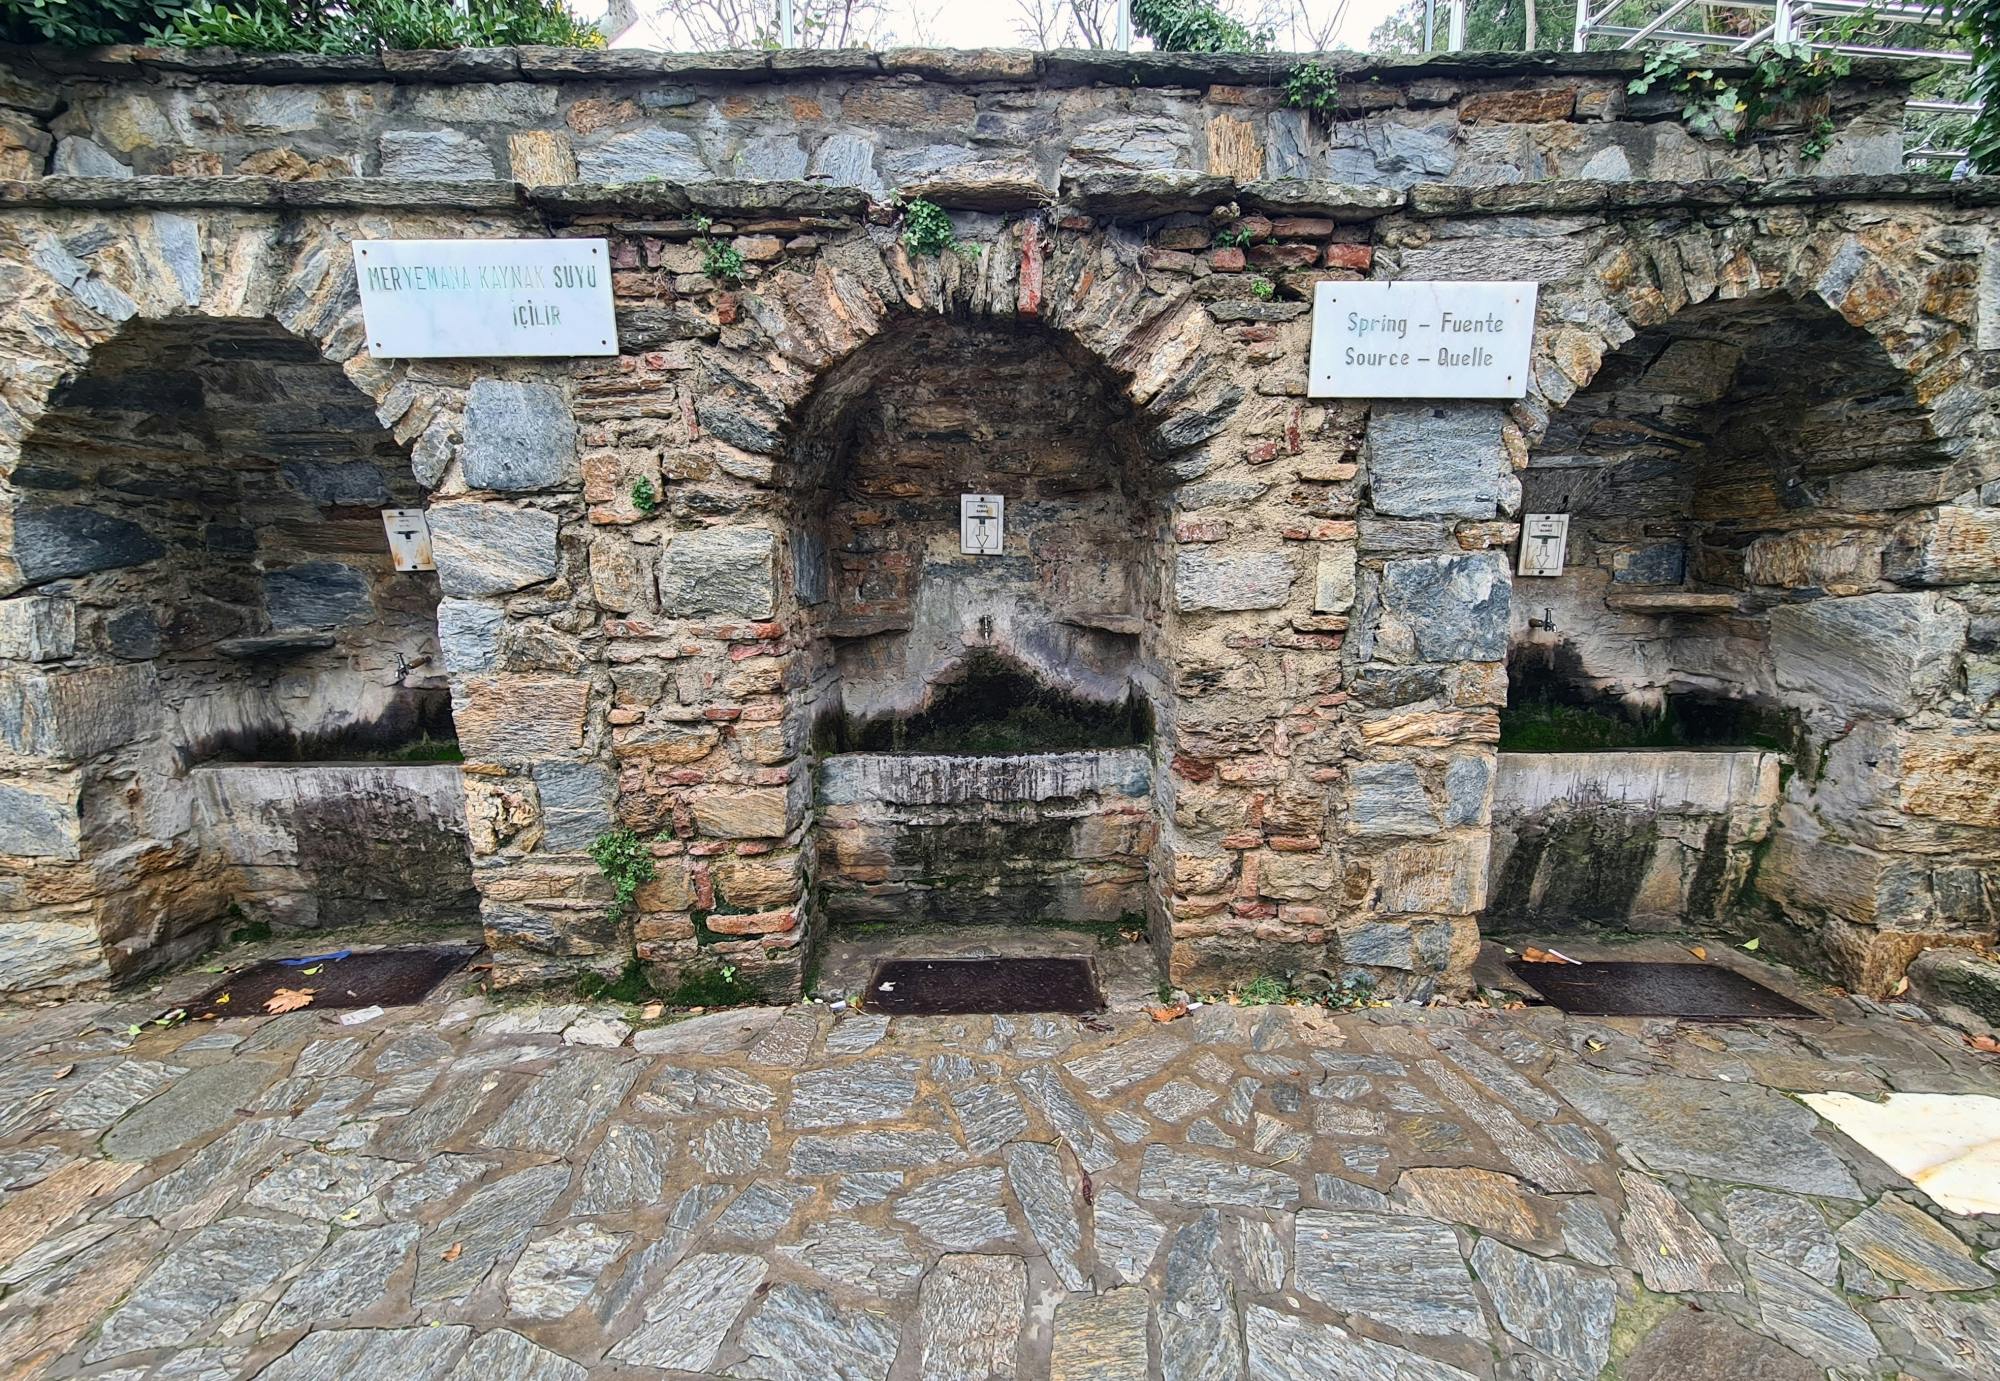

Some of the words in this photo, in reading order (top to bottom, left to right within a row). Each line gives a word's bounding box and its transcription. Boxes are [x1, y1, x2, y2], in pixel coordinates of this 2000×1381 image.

[367, 266, 472, 291] MERYEMANA
[478, 265, 545, 289] KAYNAK
[553, 265, 597, 289] SUYU
[1347, 312, 1408, 339] Spring
[1441, 312, 1504, 333] Fuente
[1345, 347, 1410, 366] Source
[1437, 347, 1493, 367] Quelle
